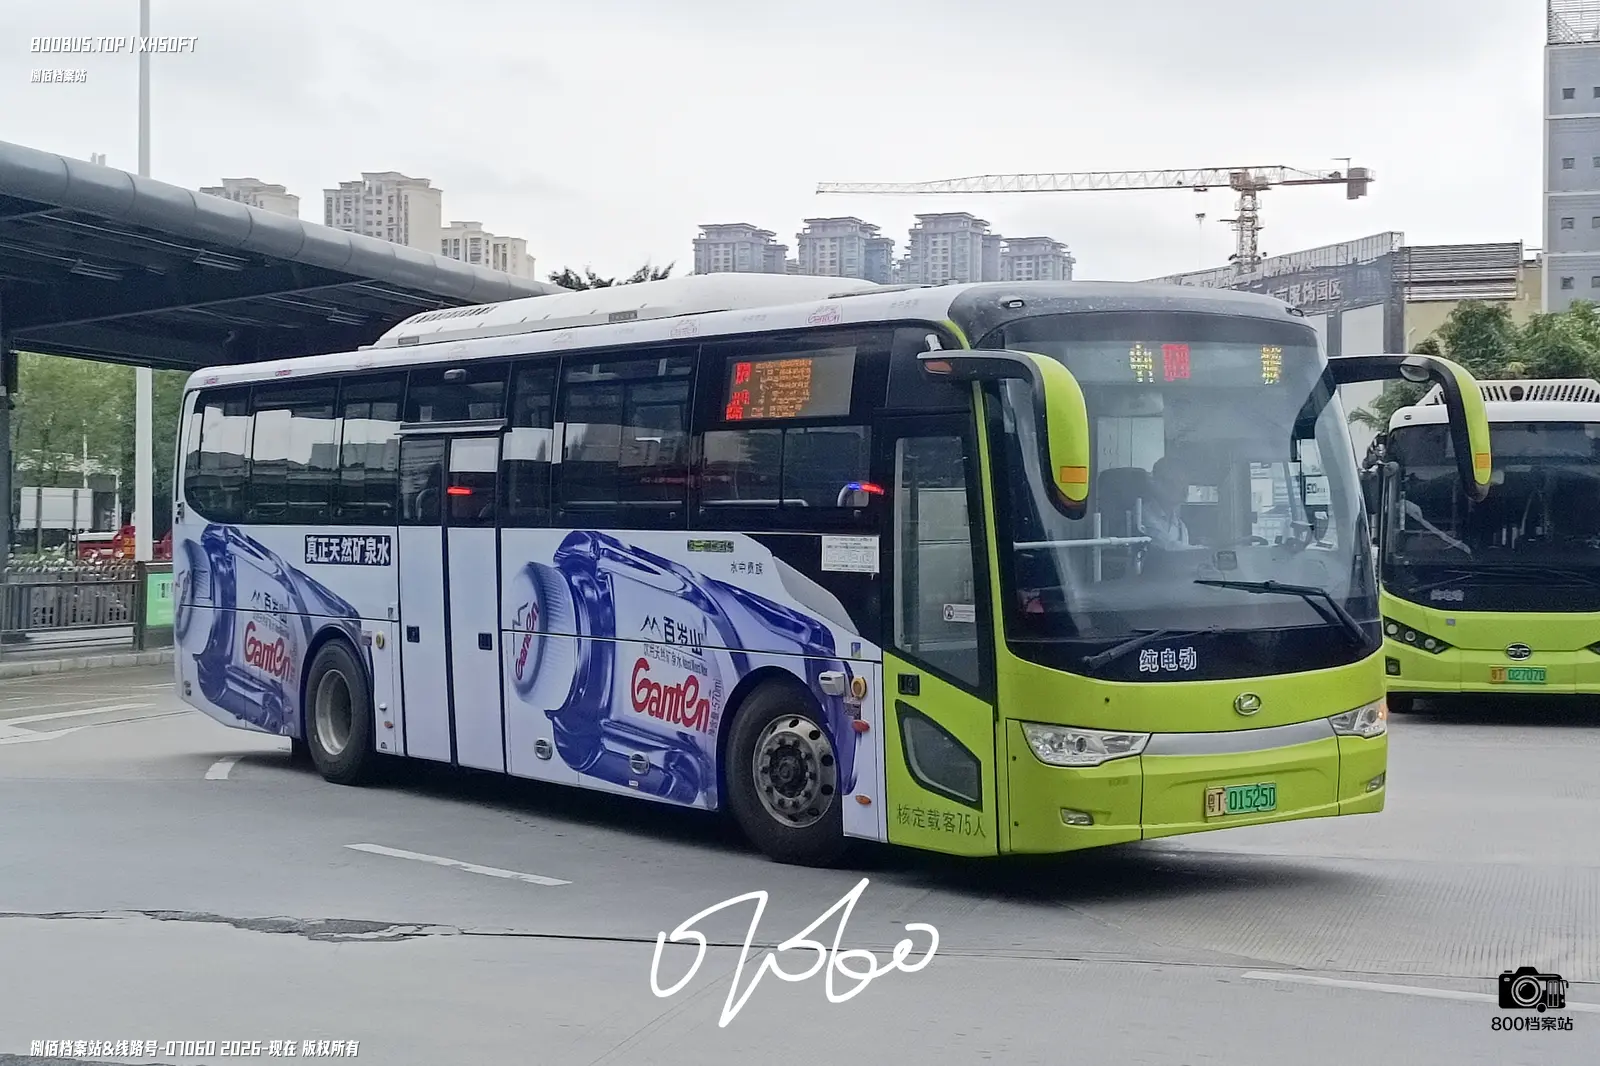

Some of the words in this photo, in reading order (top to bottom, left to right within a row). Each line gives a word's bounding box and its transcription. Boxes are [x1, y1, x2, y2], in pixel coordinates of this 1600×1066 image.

[305, 536, 390, 565] 真正天然矿泉水
[244, 620, 291, 682] Ganten
[663, 616, 703, 656] 百岁山
[1139, 646, 1197, 673] 纯电动
[631, 657, 710, 733] Ganten
[896, 803, 987, 839] 核定载客75人
